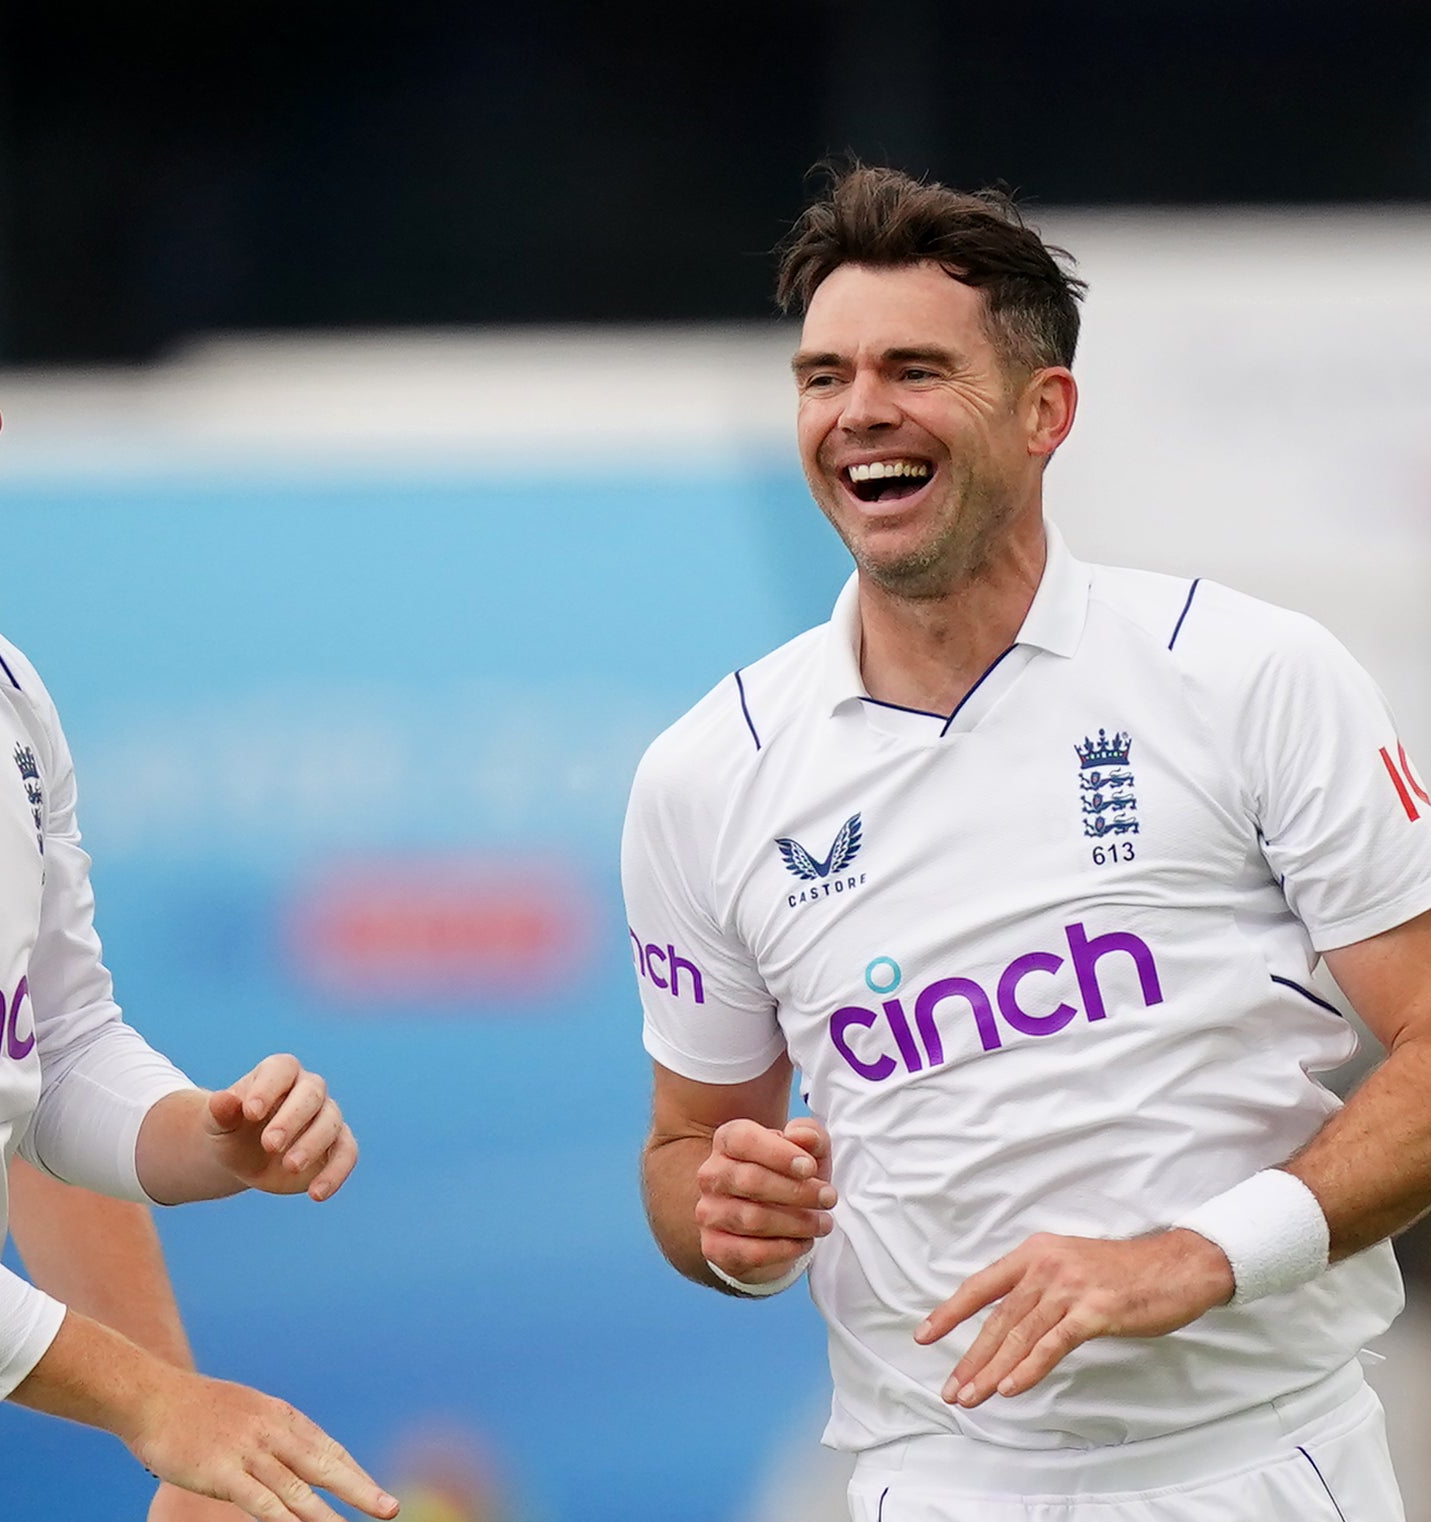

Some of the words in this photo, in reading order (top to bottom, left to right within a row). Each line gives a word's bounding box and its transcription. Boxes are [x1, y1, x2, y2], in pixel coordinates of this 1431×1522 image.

[1092, 841, 1136, 866] 613
[787, 872, 867, 908] CASTORE
[829, 921, 1164, 1083] cinch
